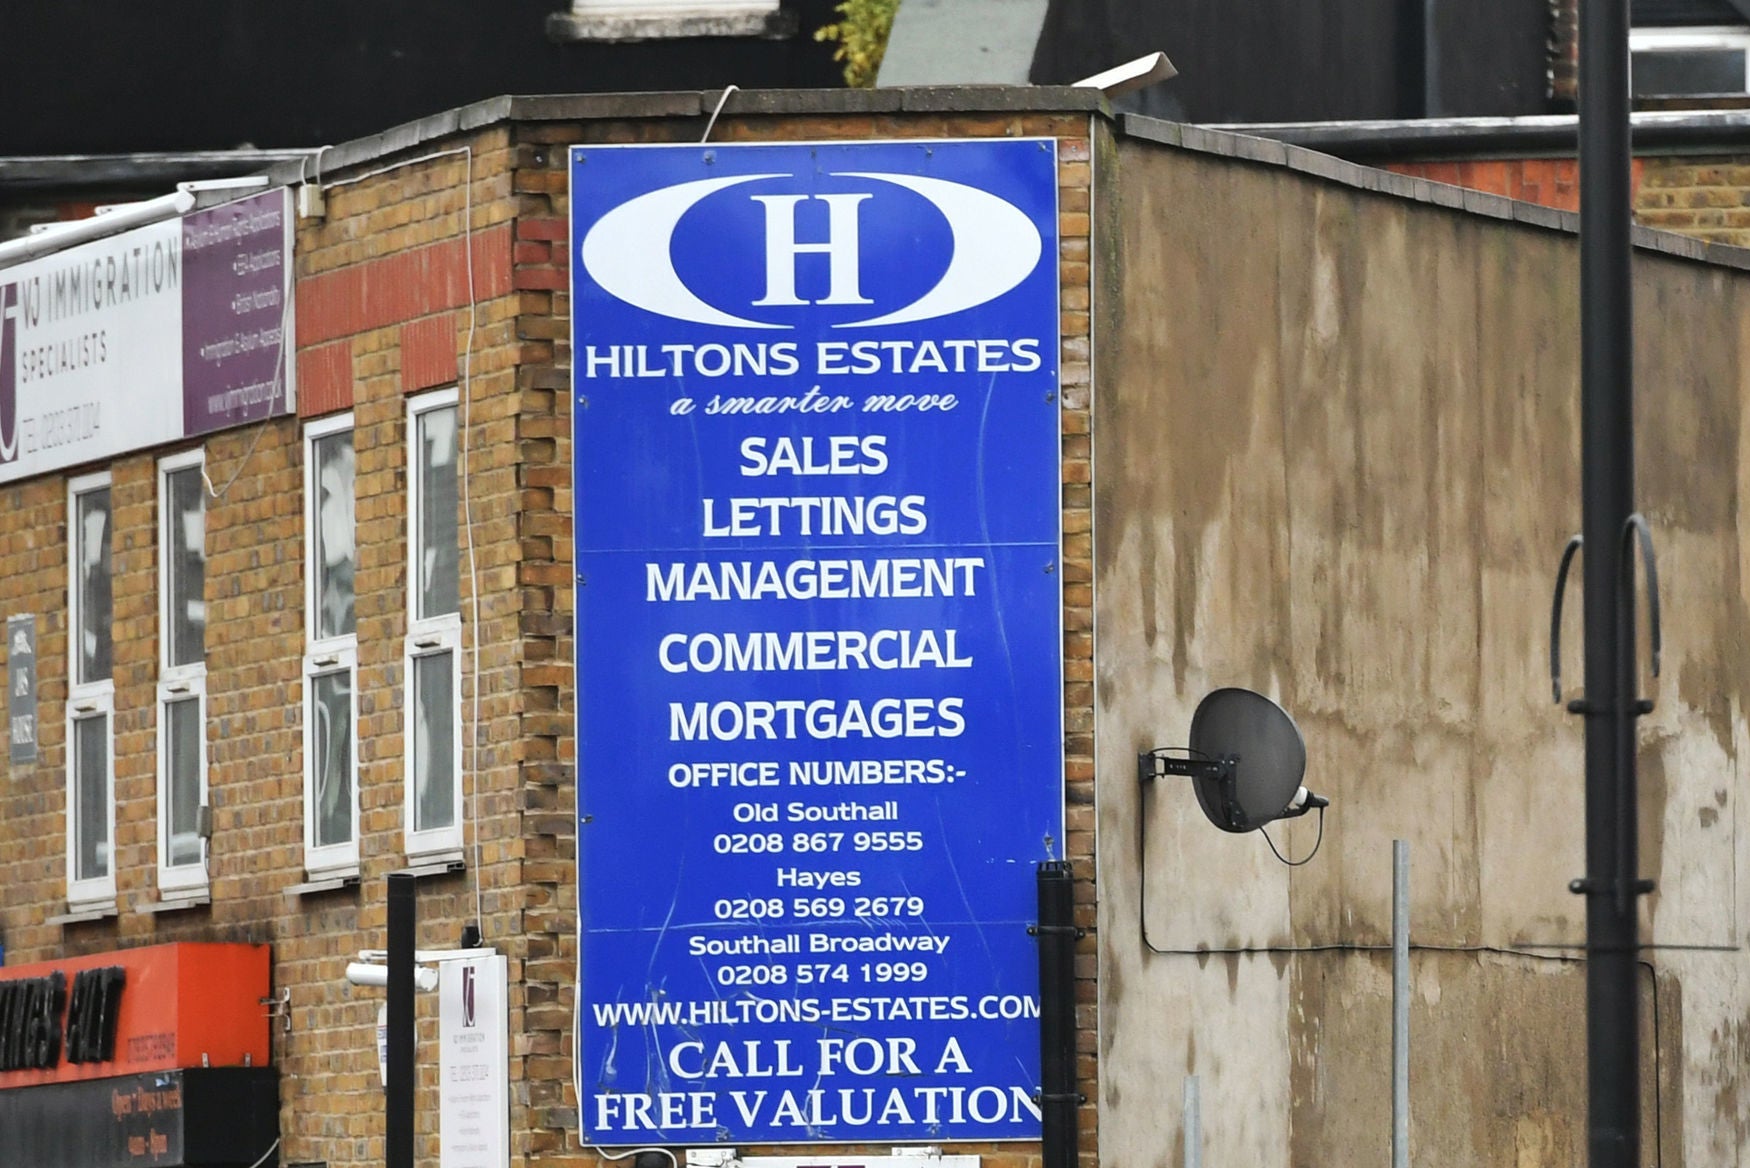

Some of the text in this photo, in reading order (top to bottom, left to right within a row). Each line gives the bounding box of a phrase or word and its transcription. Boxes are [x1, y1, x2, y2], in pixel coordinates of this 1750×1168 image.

[750, 193, 874, 306] H
[48, 237, 178, 322] IMMIGRATION
[23, 330, 107, 383] SPECIALISTS
[585, 339, 1041, 378] HILTONS ESTATES
[670, 385, 959, 416] a smarter move
[740, 435, 888, 476] SALES
[702, 495, 927, 537] LETTINGS
[646, 557, 984, 602] MANAGEMENT
[659, 628, 973, 674] COMMERCIAL
[668, 697, 966, 742] MORTGAGES
[668, 760, 966, 787] OFFICE NUMBERS:-
[733, 801, 899, 823] Old Southall
[713, 831, 924, 854] 0208 867 9555
[776, 867, 861, 892] Hayes
[714, 896, 925, 919] 0208 569 2679
[689, 931, 950, 959] Southall Broadway
[717, 962, 928, 986] 0208 574 1999
[668, 1036, 972, 1080] CALL FOR A
[594, 1085, 1043, 1132] FREE VALUATION
